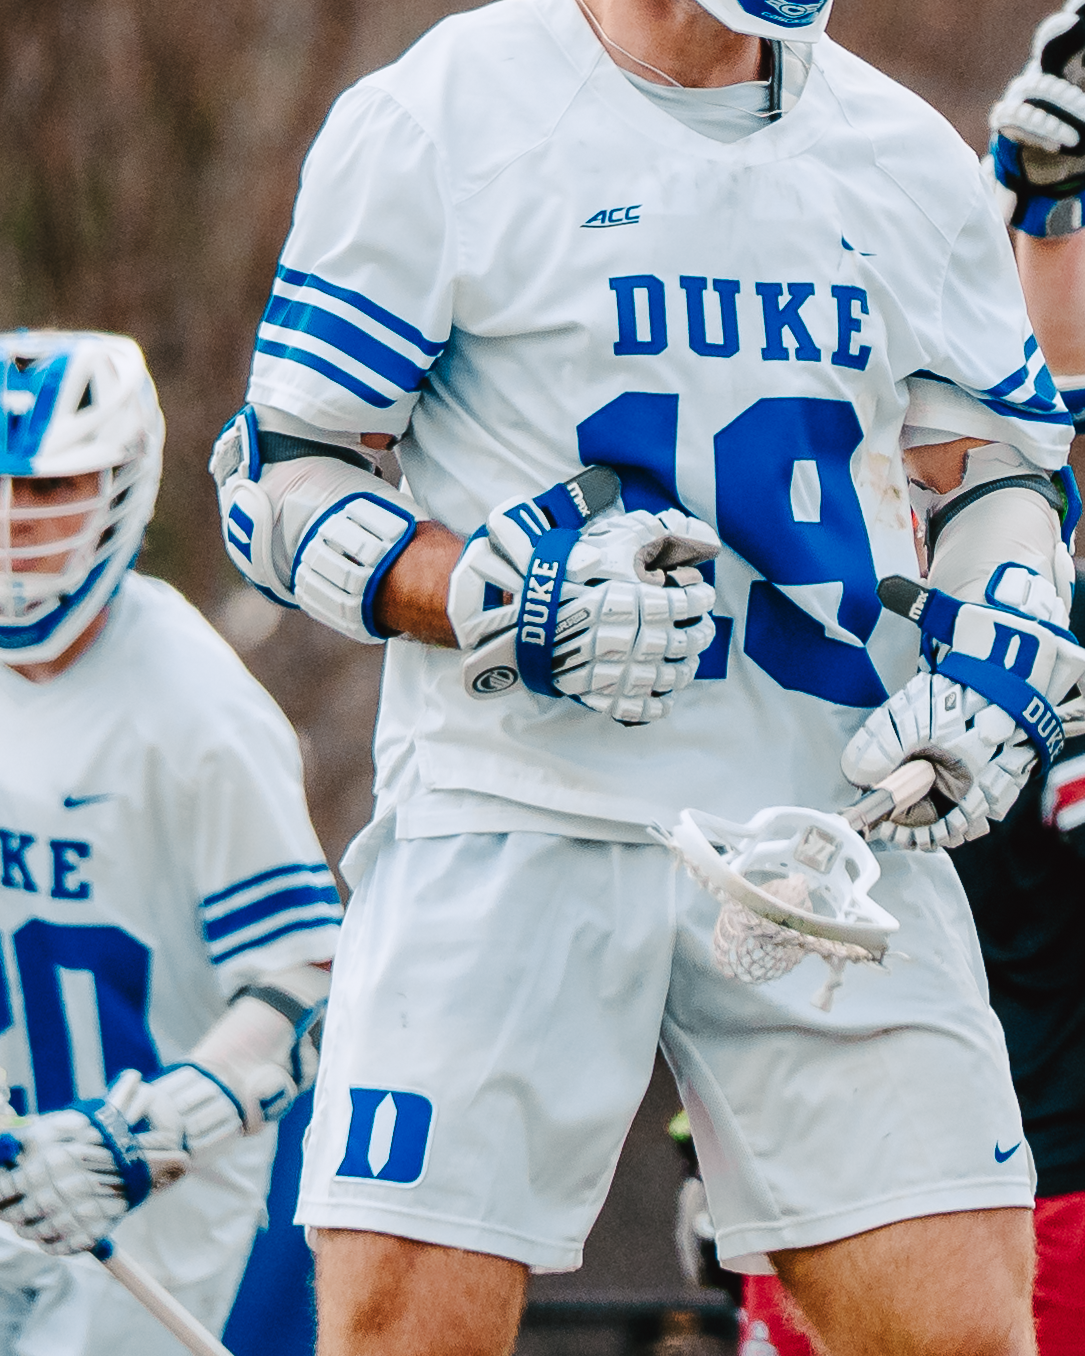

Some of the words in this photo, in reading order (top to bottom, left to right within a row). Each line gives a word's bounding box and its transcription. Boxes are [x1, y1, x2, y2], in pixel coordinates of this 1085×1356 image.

[584, 204, 644, 226] ACC
[608, 274, 873, 372] DUKE
[521, 558, 560, 646] DUKE
[0, 916, 164, 1115] 0
[335, 1087, 434, 1185] D
